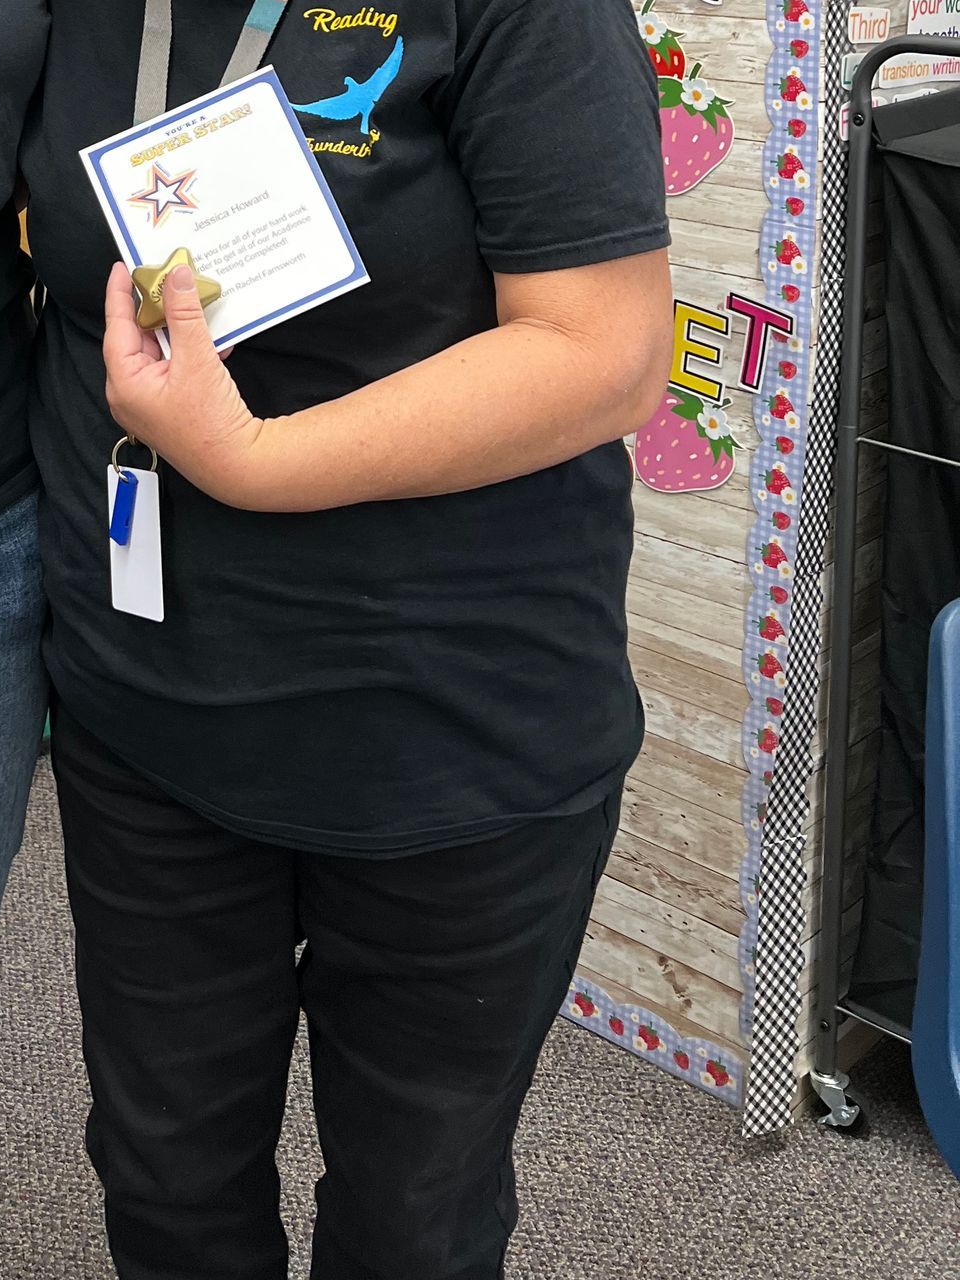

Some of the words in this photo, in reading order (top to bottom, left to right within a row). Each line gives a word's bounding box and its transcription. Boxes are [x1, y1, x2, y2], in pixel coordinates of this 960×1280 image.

[303, 7, 398, 37] Reading
[850, 11, 888, 41] Third
[882, 61, 929, 81] transition
[130, 132, 193, 168] SUPER
[193, 210, 230, 232] Jessica
[230, 190, 270, 214] Howard
[197, 261, 213, 273] rder
[213, 256, 223, 266] to
[223, 251, 237, 263] get
[237, 244, 247, 255] all
[247, 239, 256, 250] of
[257, 235, 270, 245] our
[271, 215, 312, 239] Acadience
[204, 247, 219, 260] you
[219, 241, 231, 253] for
[232, 235, 241, 246] all
[242, 230, 250, 241] of
[251, 223, 269, 237] your
[268, 214, 288, 227] hard
[287, 205, 308, 218] work
[215, 260, 244, 277] Testing
[244, 237, 289, 263] Completed!
[235, 272, 262, 289] Rachel
[262, 252, 307, 277] Farnsworth
